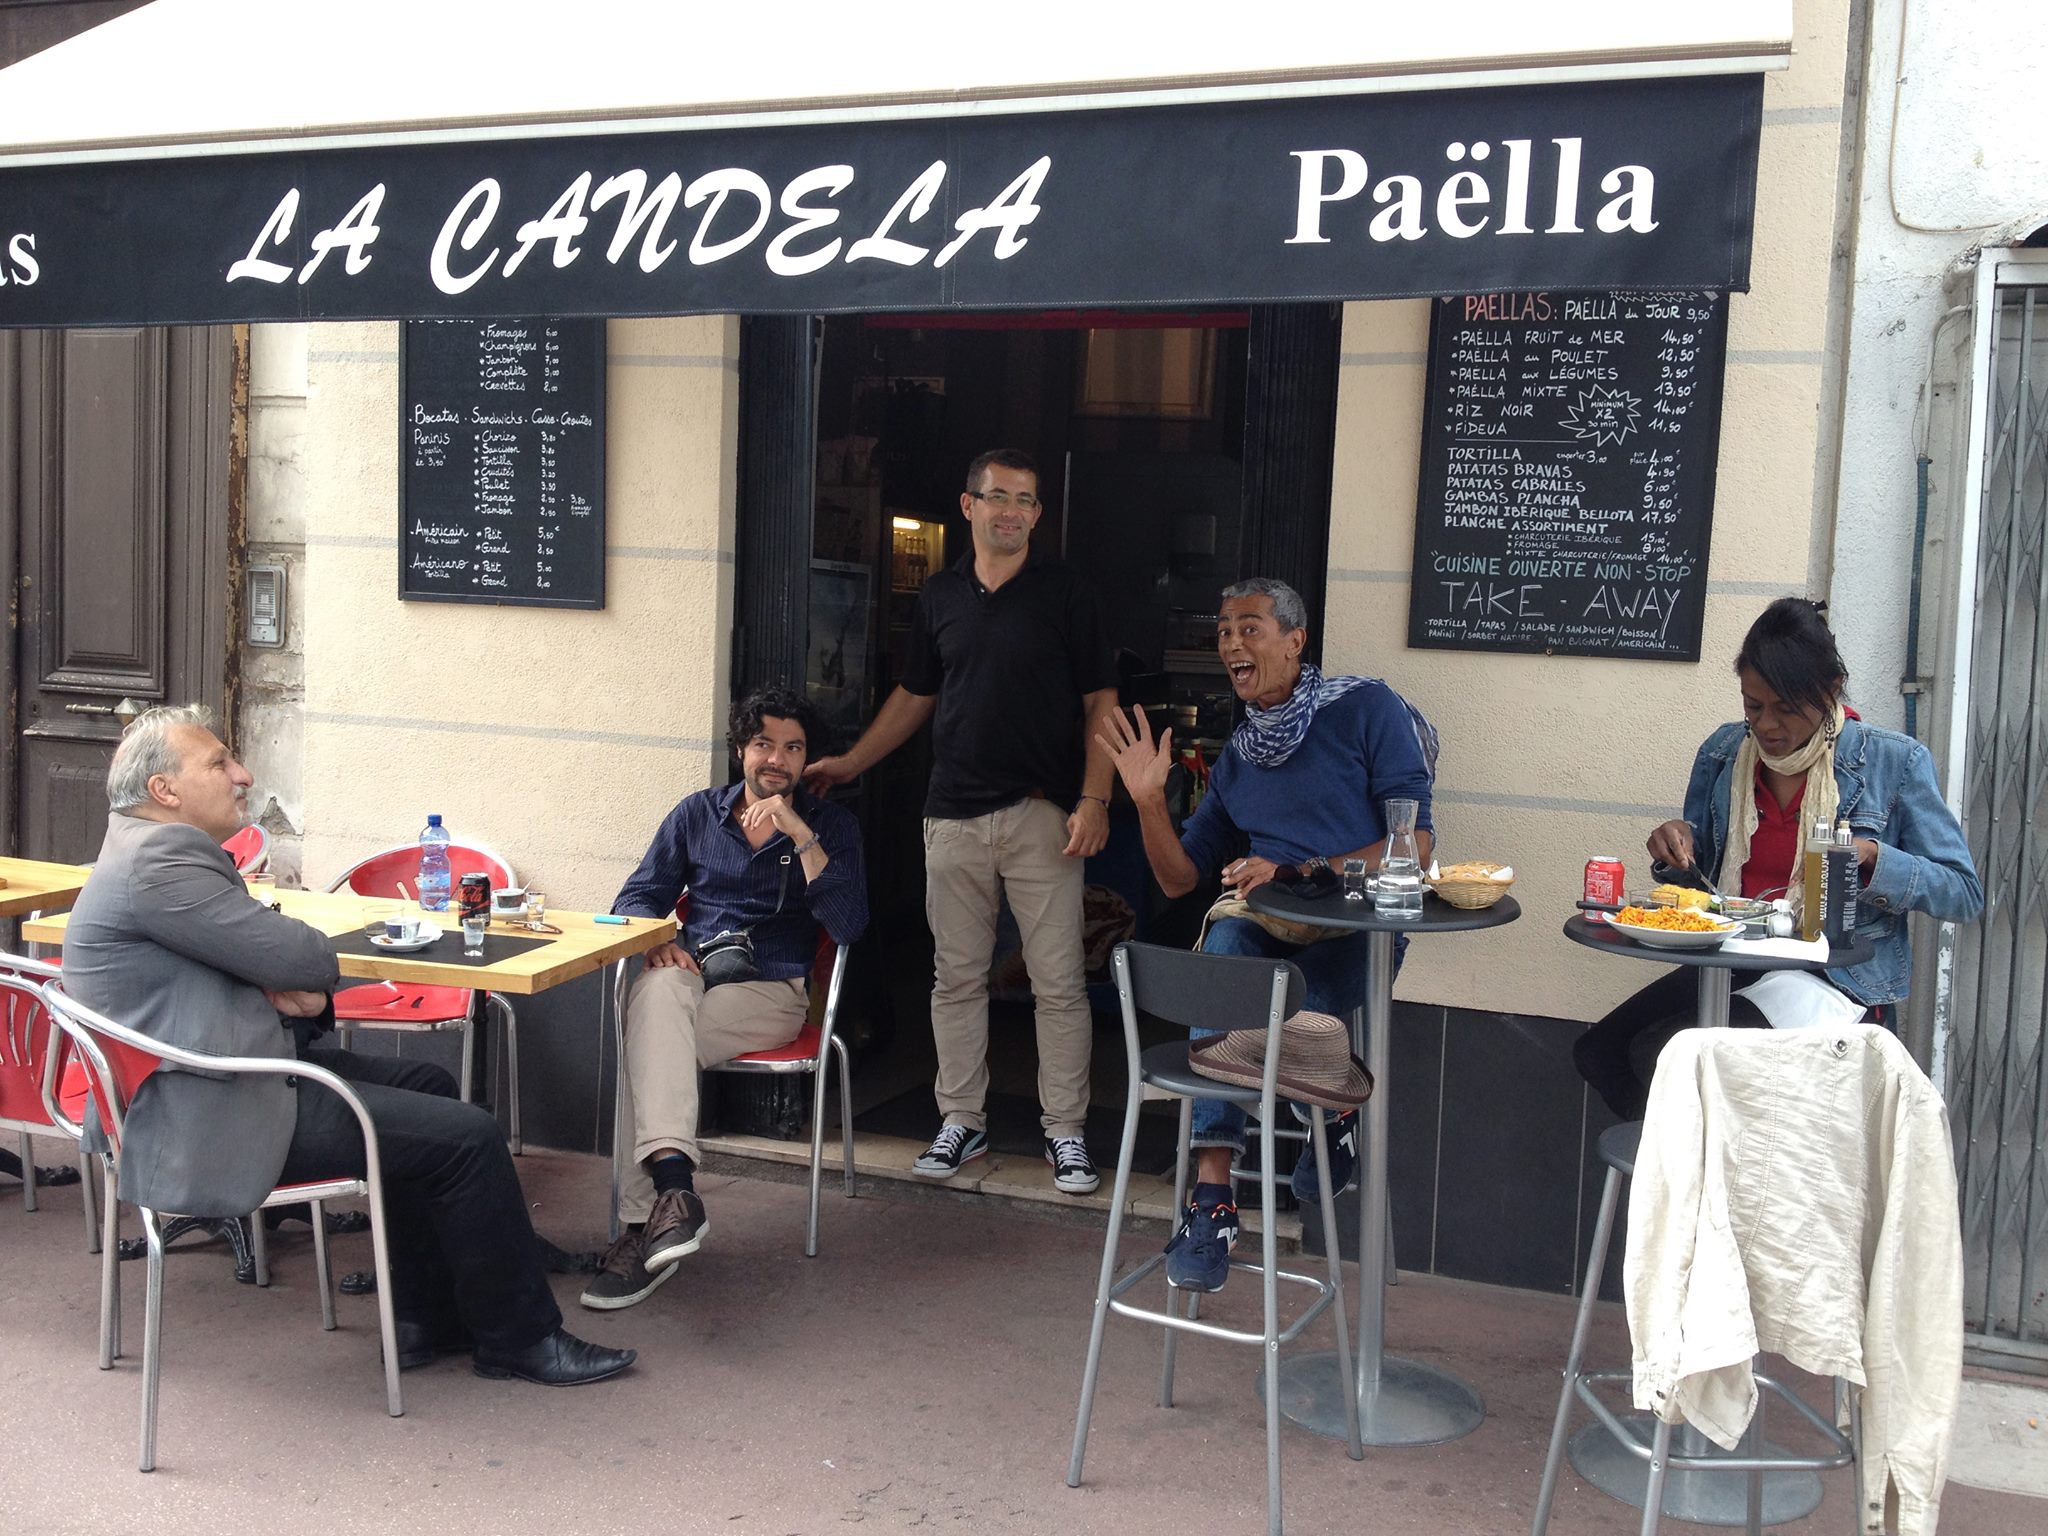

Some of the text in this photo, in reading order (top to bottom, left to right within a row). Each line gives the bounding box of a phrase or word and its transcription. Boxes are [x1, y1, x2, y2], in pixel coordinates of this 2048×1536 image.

[1284, 137, 1659, 246] Paëlla
[226, 156, 1051, 296] LA CANDELA
[1625, 307, 1639, 319] du
[1645, 304, 1681, 319] JOUR
[1568, 333, 1584, 344] de
[1590, 330, 1625, 344] MER
[485, 355, 519, 365] Jambon
[1524, 354, 1540, 362] au
[1551, 349, 1608, 364] POULET
[1521, 371, 1539, 380] aux
[415, 404, 460, 425] Bocatas
[471, 406, 523, 425] Sandwichs
[1600, 420, 1619, 429] min
[1648, 419, 1681, 433] 11,50
[414, 428, 450, 445] Paninis
[481, 430, 517, 442] Chorizo
[415, 458, 425, 466] de
[481, 455, 513, 466] Tortilla
[1447, 463, 1509, 477] PATATAS
[1514, 464, 1573, 479] BRAVAS
[480, 478, 510, 491] Poulet
[1446, 477, 1504, 490] PATATAS
[1511, 478, 1586, 492] CABRALES
[1445, 490, 1509, 504] GAMBAS
[1518, 493, 1580, 509] PLANCHA
[481, 503, 513, 516] Jambon
[1444, 503, 1498, 516] JAMBON
[1579, 509, 1635, 522] BELLOTA
[1444, 516, 1608, 535] PLANCHE ASSORTIMENT
[1514, 533, 1571, 542] CHARCUTERIE
[481, 542, 511, 554] Grand
[1514, 541, 1559, 550] FROMAGE
[1508, 560, 1587, 578] OUVERTE
[480, 574, 508, 587] Grand
[1440, 581, 1544, 617] TAKE
[1583, 584, 1681, 640] AWAY
